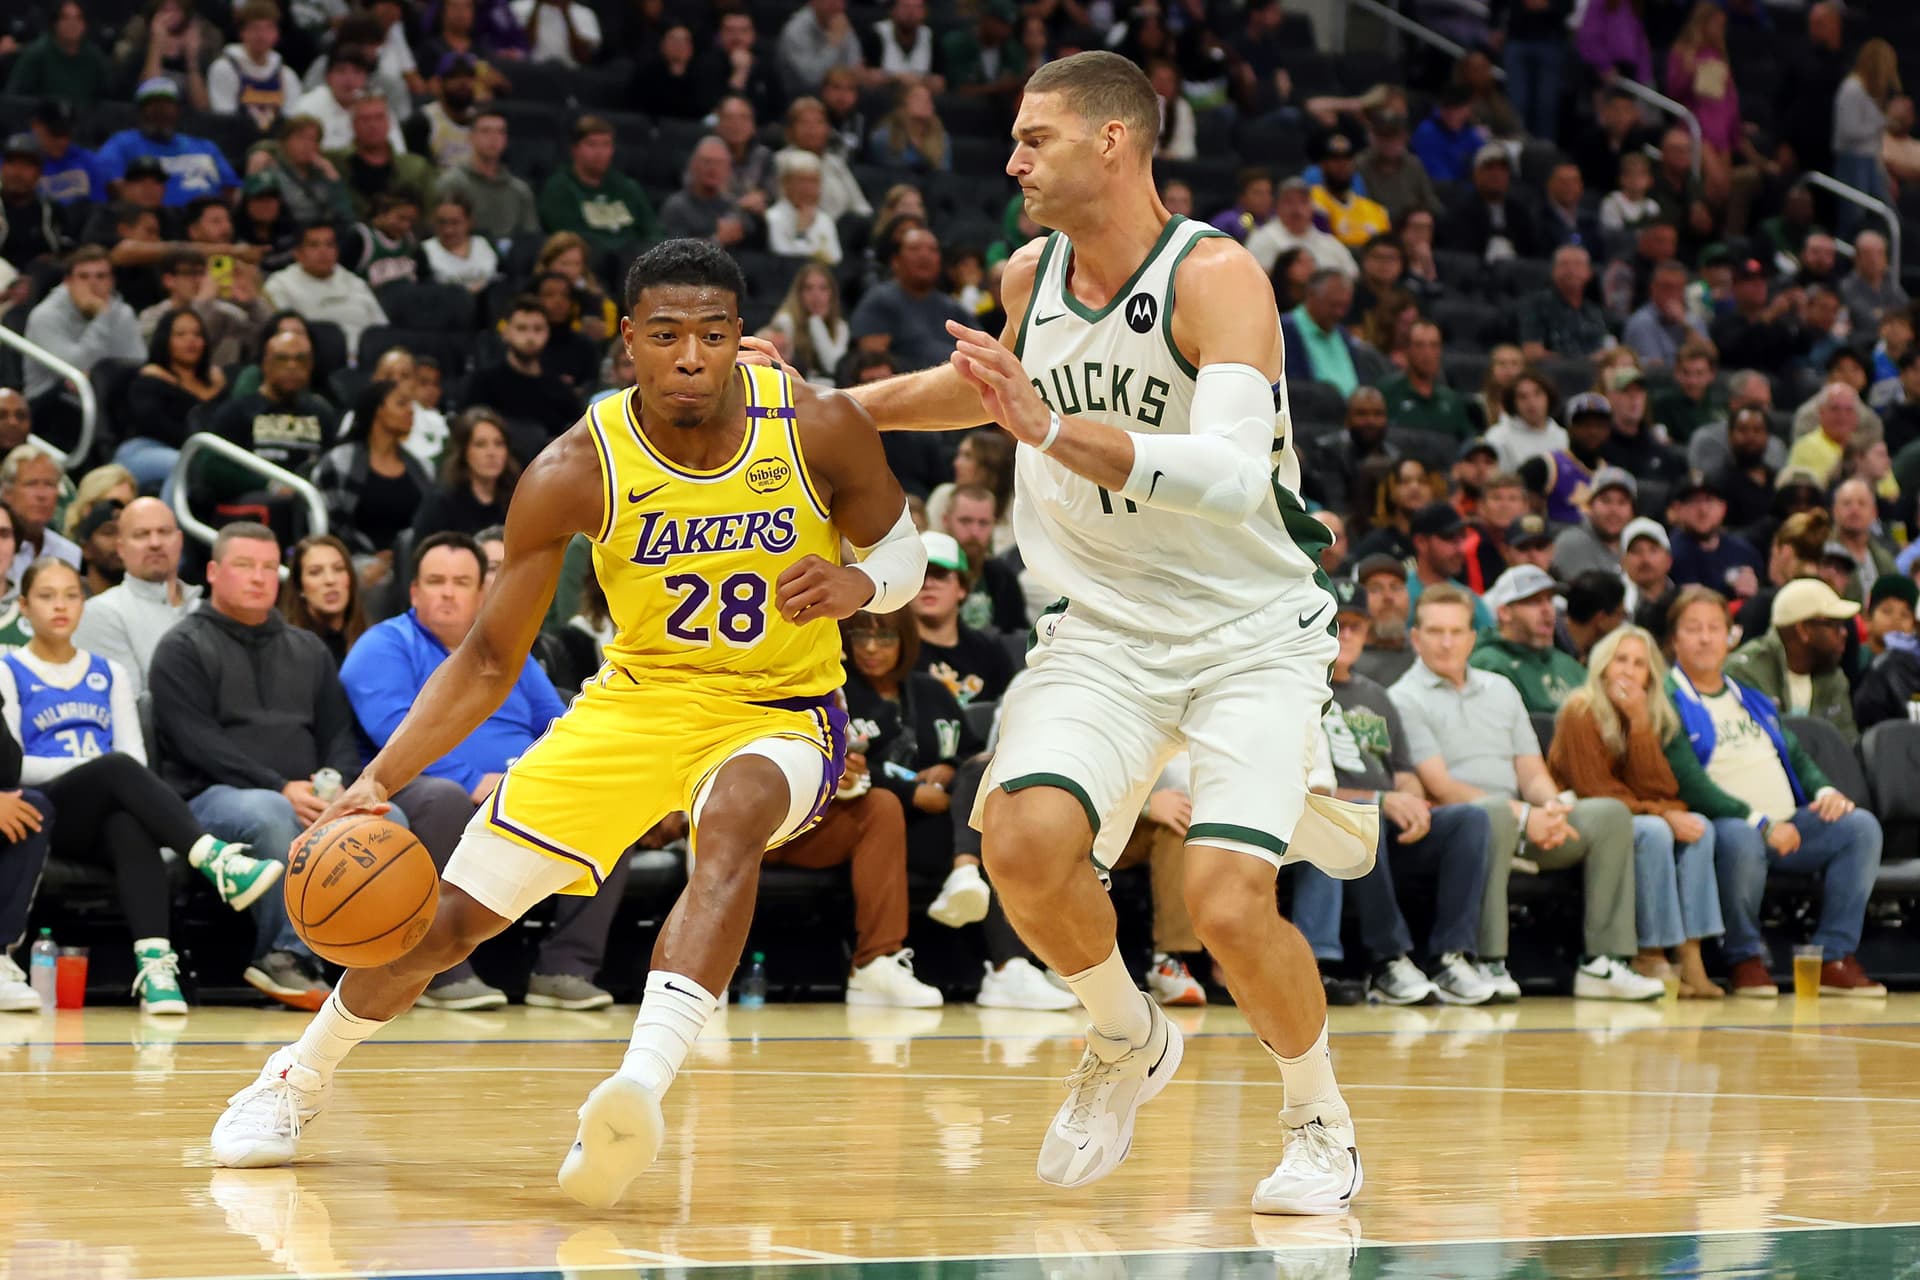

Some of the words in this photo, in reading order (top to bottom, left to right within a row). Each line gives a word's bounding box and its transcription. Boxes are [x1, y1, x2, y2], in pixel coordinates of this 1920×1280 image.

[749, 466, 788, 482] bibigo
[629, 506, 798, 566] LAKERS
[664, 571, 769, 649] 28
